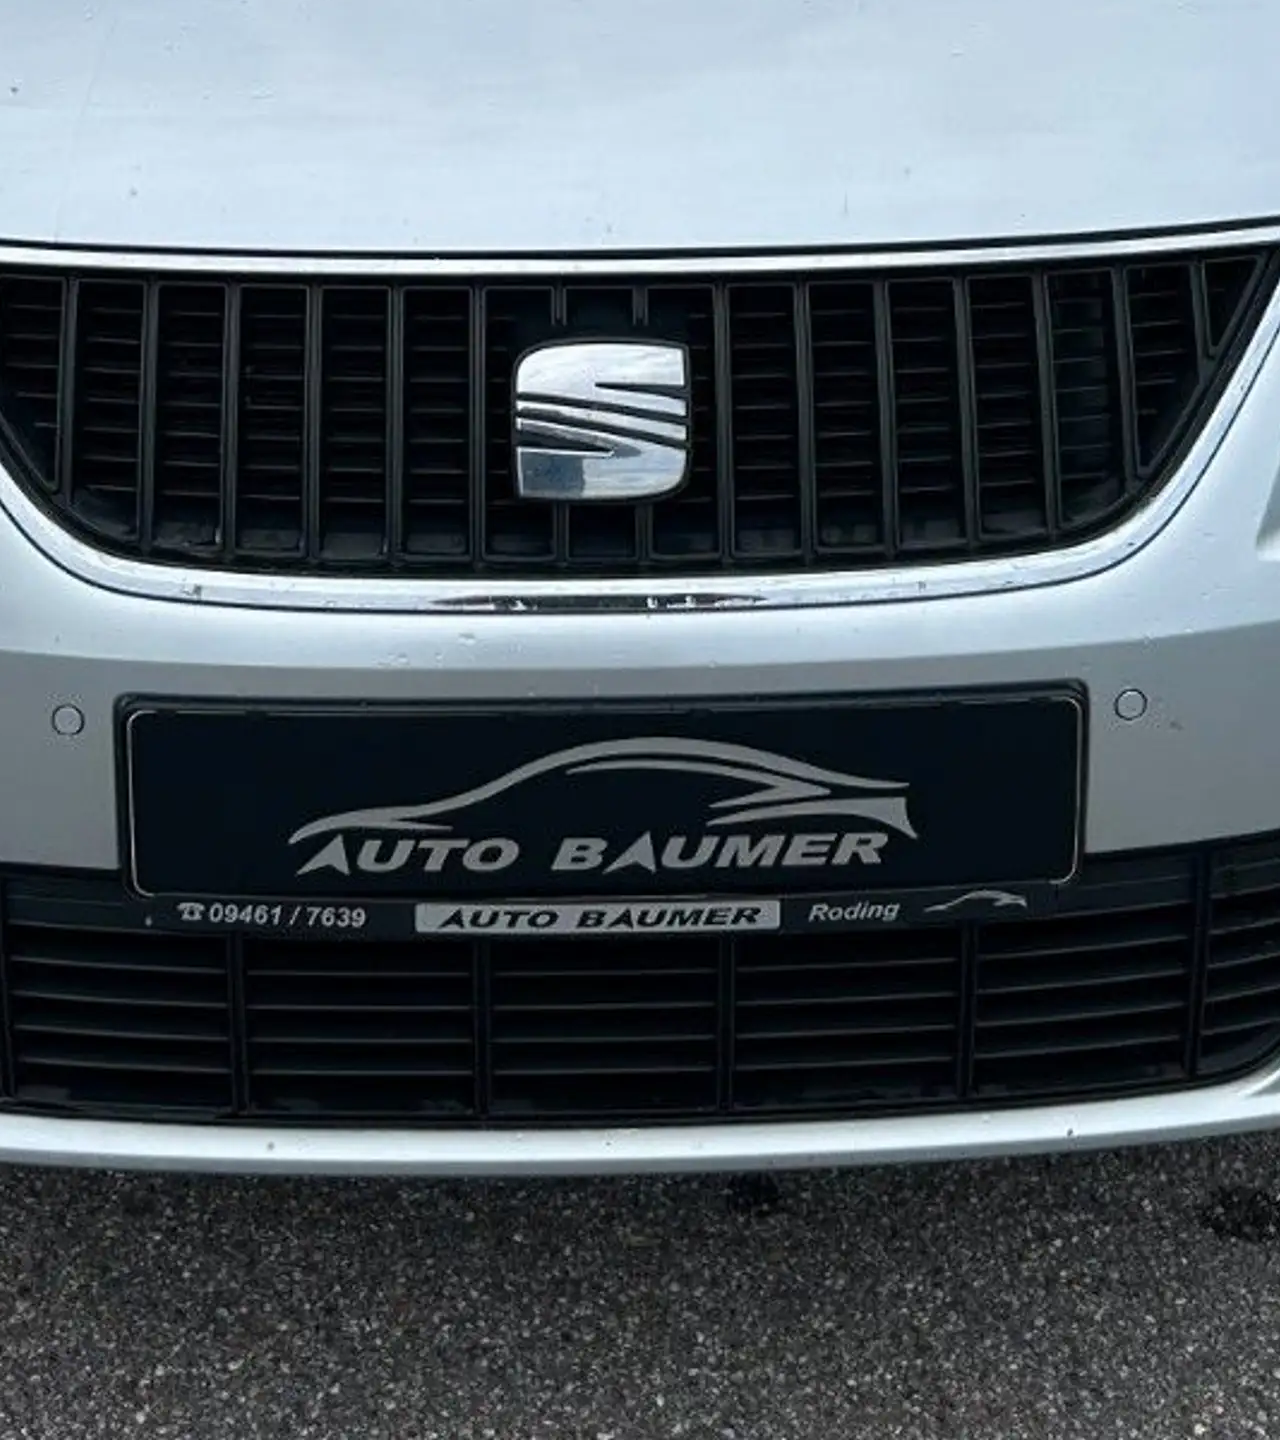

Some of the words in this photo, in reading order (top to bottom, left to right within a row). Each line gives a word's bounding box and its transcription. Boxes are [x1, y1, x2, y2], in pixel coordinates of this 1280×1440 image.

[296, 833, 520, 876] AUTO
[551, 830, 889, 874] BAUMER
[208, 902, 282, 926] 09461
[306, 907, 367, 928] 7639
[440, 909, 560, 929] AUTO
[575, 905, 762, 929] BAUMER
[808, 901, 901, 924] Roding
